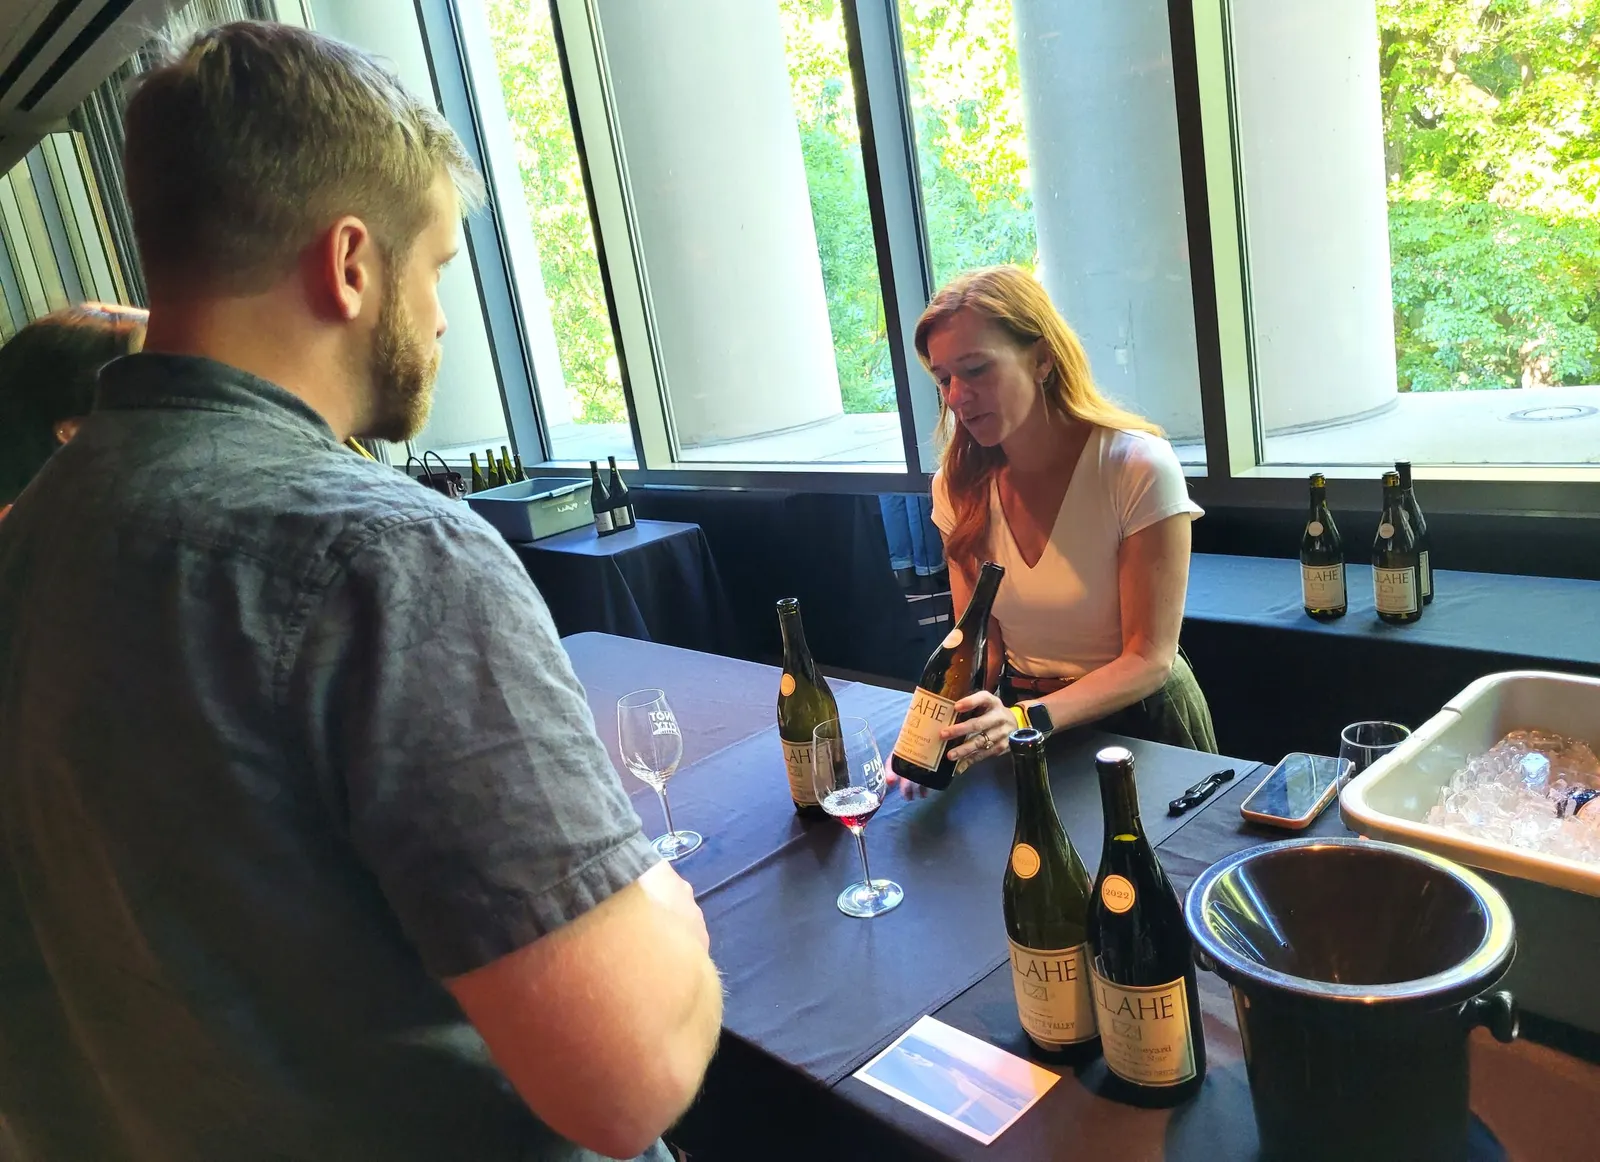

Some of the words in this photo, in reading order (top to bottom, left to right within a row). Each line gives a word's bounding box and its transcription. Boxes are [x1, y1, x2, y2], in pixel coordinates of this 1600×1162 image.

[1375, 571, 1409, 584] LAHE
[910, 697, 948, 723] AHE
[1105, 887, 1130, 900] 2022
[1013, 951, 1078, 983] LAHE
